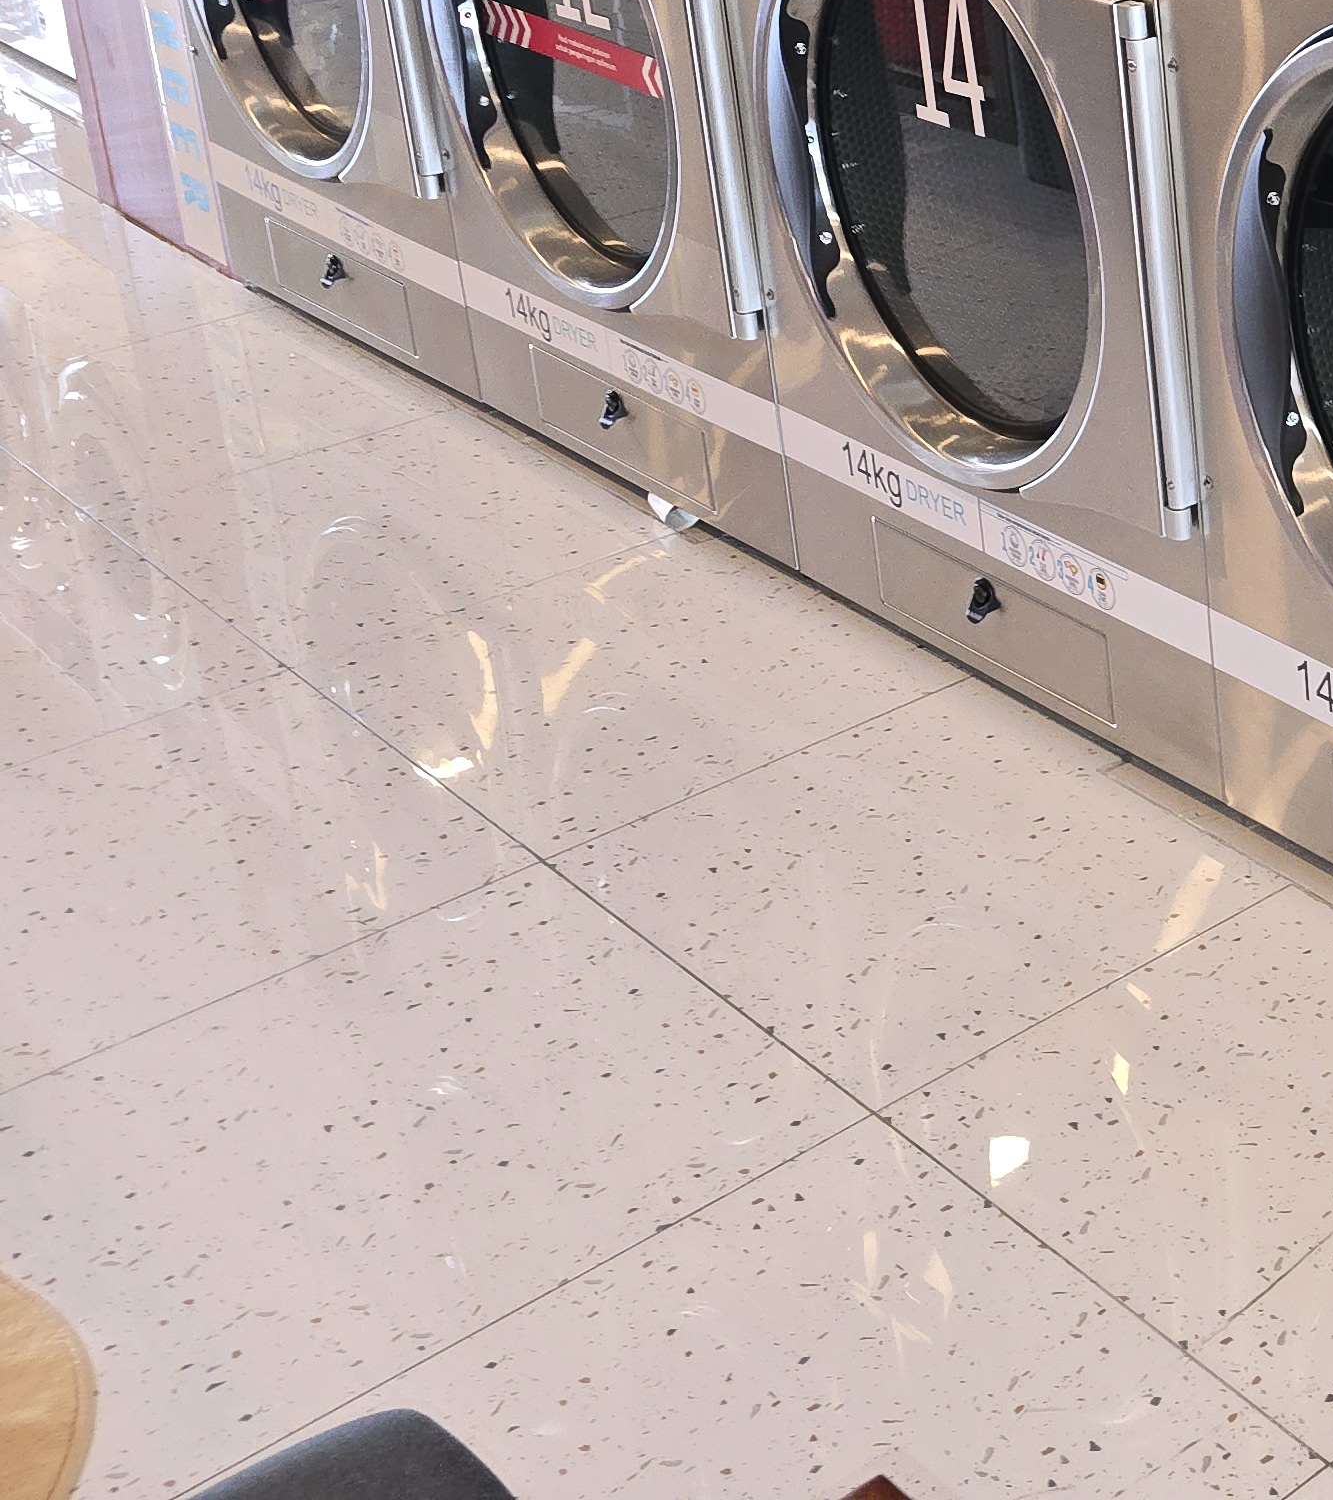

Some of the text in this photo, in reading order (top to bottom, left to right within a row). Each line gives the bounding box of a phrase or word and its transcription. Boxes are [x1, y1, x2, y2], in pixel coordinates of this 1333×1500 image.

[244, 164, 283, 211] 14kg
[504, 287, 598, 353] 14kg DRYER
[842, 441, 967, 526] 14kg DRYER
